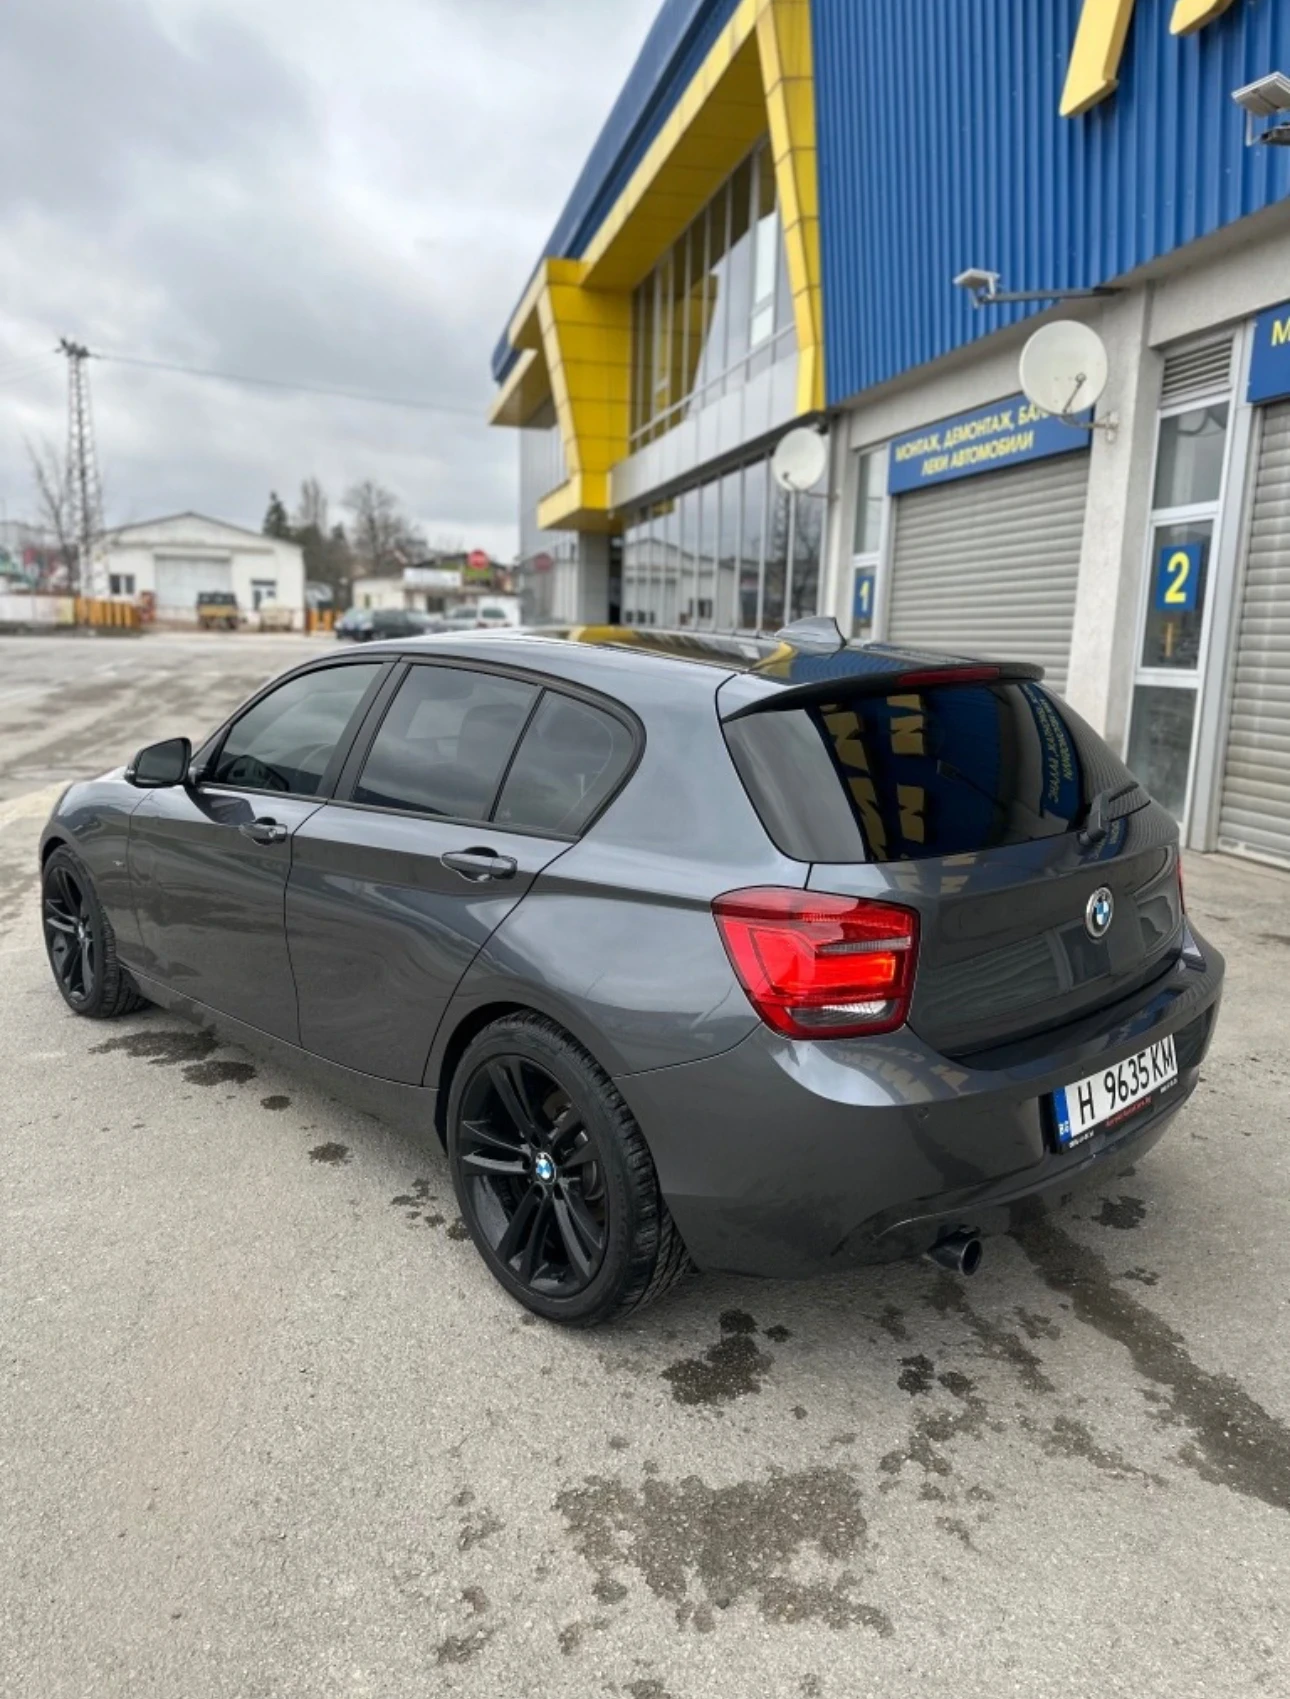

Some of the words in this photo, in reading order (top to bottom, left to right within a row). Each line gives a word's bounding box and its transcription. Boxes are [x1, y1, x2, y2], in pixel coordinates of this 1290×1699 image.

[859, 580, 870, 612] 1
[1164, 551, 1190, 604] 2
[1077, 1080, 1095, 1125] H
[1103, 1051, 1150, 1110] 9635
[1150, 1034, 1175, 1082] KM
